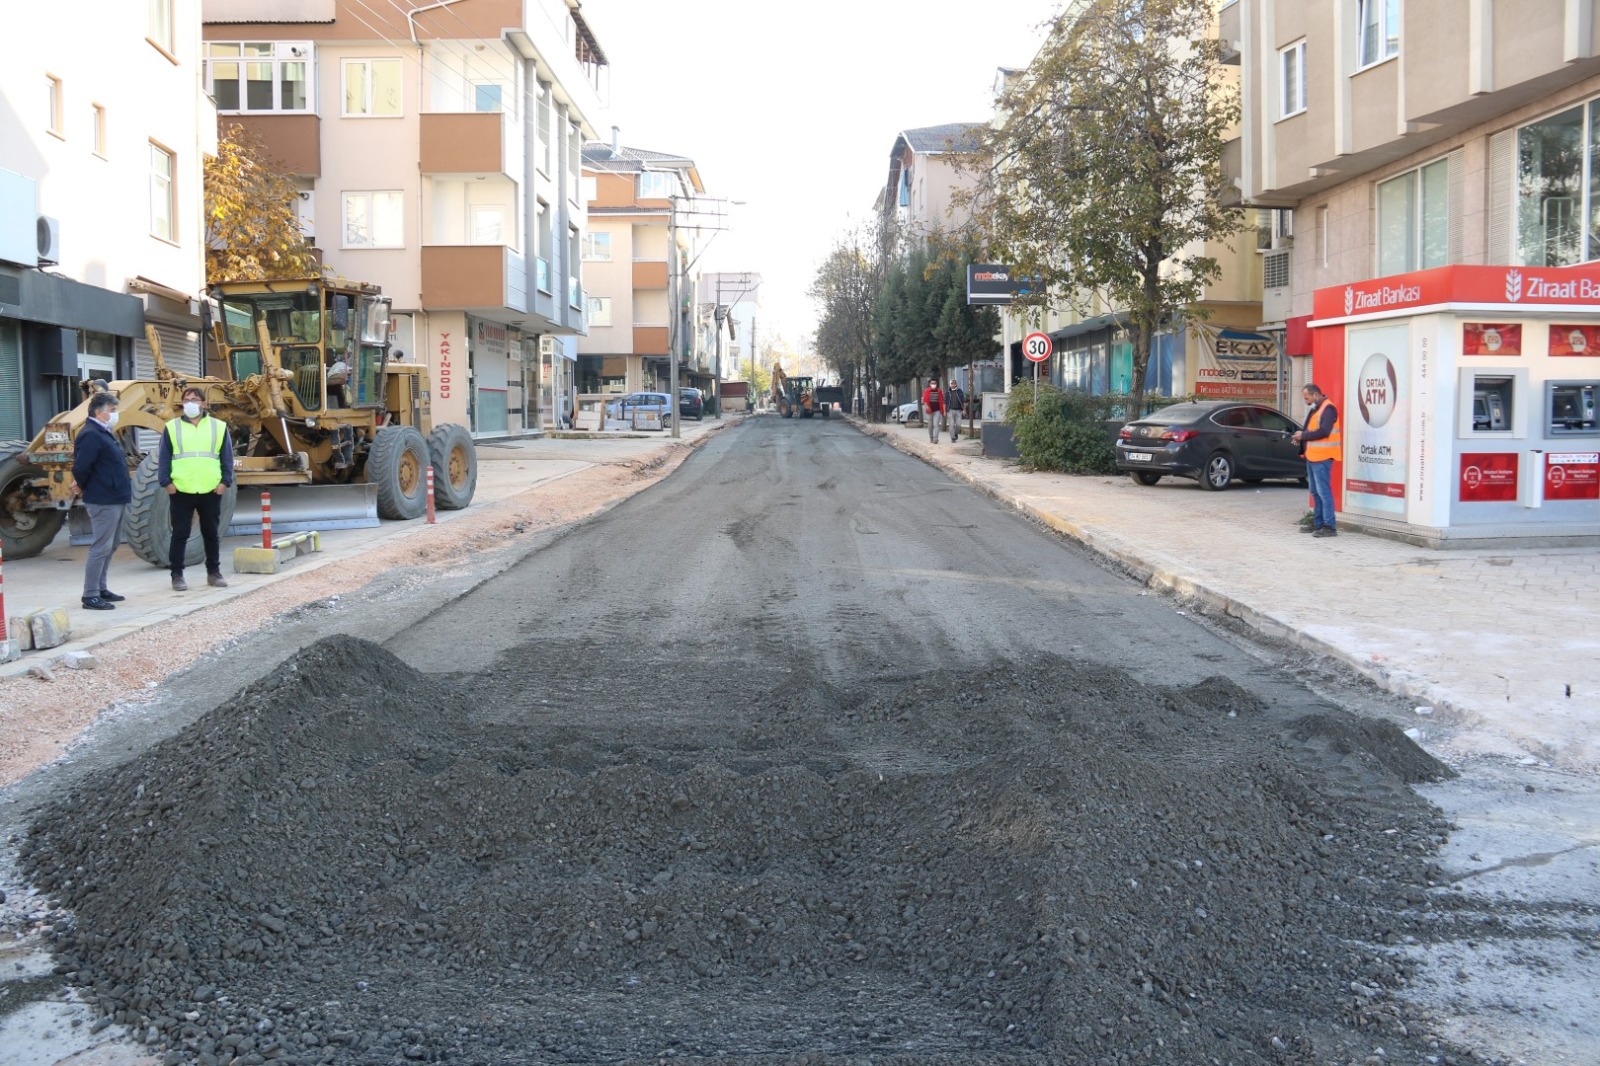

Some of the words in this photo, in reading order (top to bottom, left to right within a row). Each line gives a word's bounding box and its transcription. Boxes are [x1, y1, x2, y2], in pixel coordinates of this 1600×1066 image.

[1527, 277, 1577, 299] Ziraat
[1355, 288, 1381, 308] Ziraat
[1383, 285, 1420, 304] Bankası
[1029, 340, 1046, 355] 30
[1216, 340, 1275, 355] EKAY
[1366, 378, 1386, 388] ORTAK
[1365, 389, 1386, 405] ATM
[1361, 444, 1378, 455] Ortak
[1378, 445, 1392, 456] ATM
